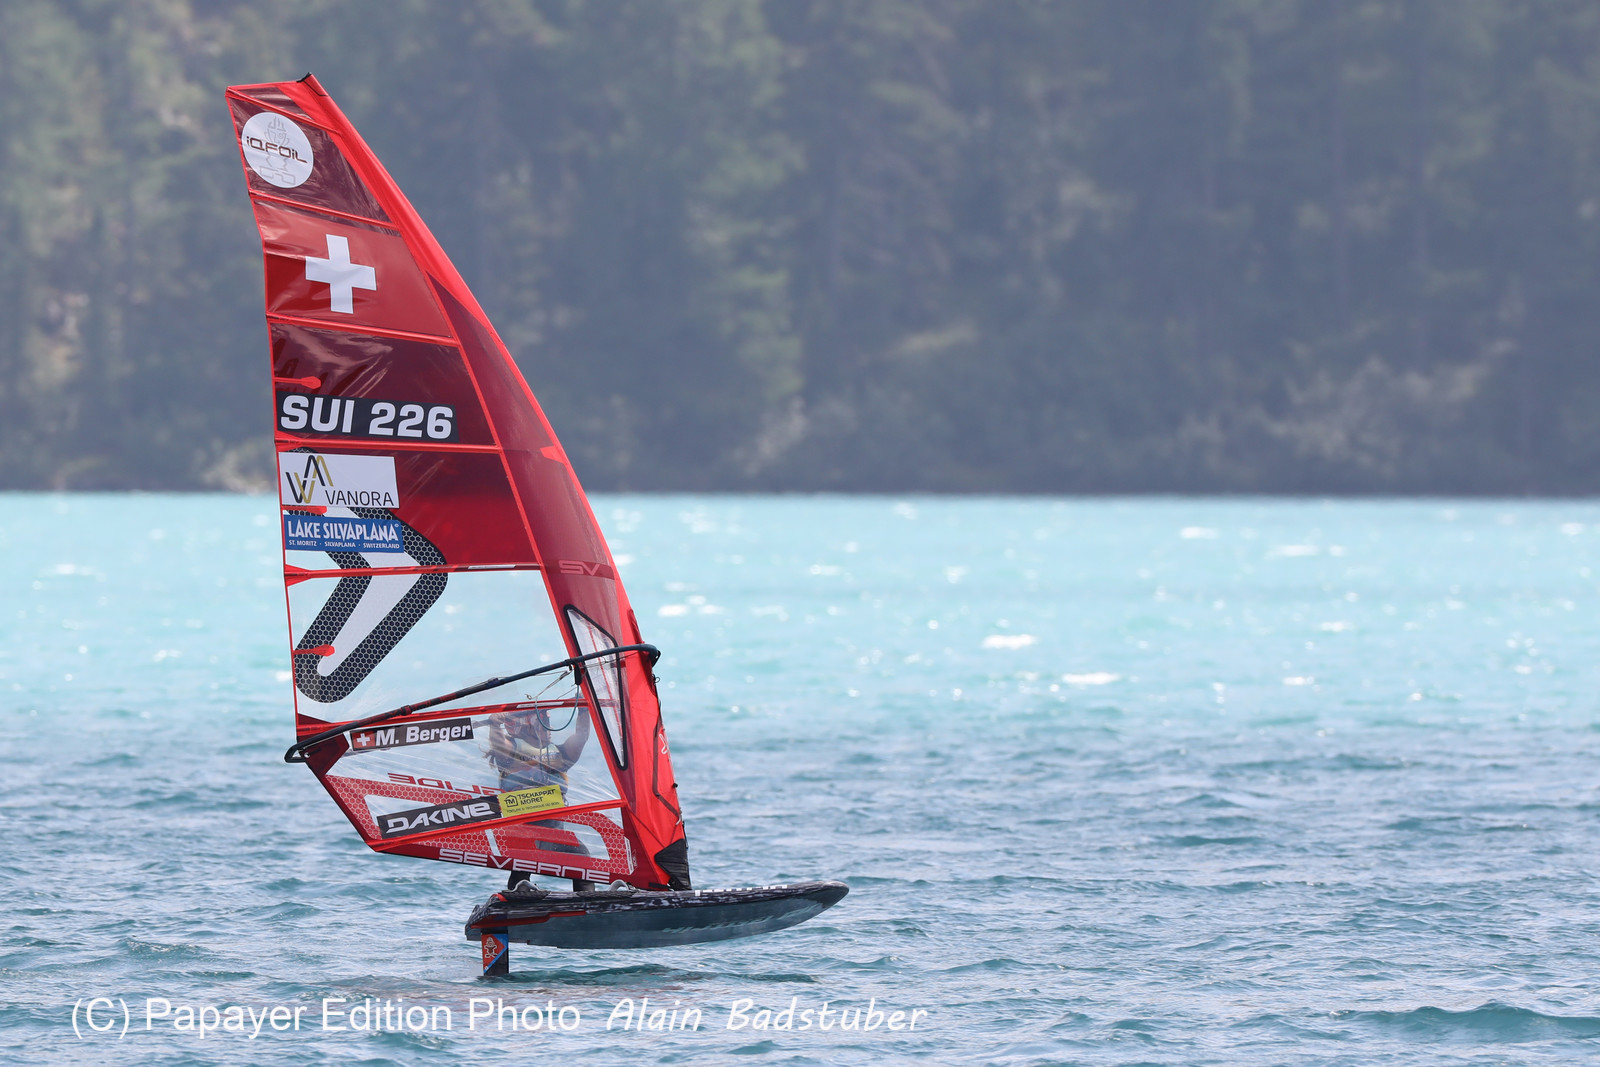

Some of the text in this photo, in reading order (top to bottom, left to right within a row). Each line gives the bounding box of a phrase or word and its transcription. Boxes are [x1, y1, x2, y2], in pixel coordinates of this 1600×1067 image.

[280, 394, 453, 439] SUI 226
[325, 489, 395, 506] VANORA
[287, 519, 321, 538] LAKE
[559, 560, 600, 576] SV
[375, 724, 472, 746] M. Berger
[385, 802, 496, 834] DAKINE
[438, 848, 611, 883] SEVERNE
